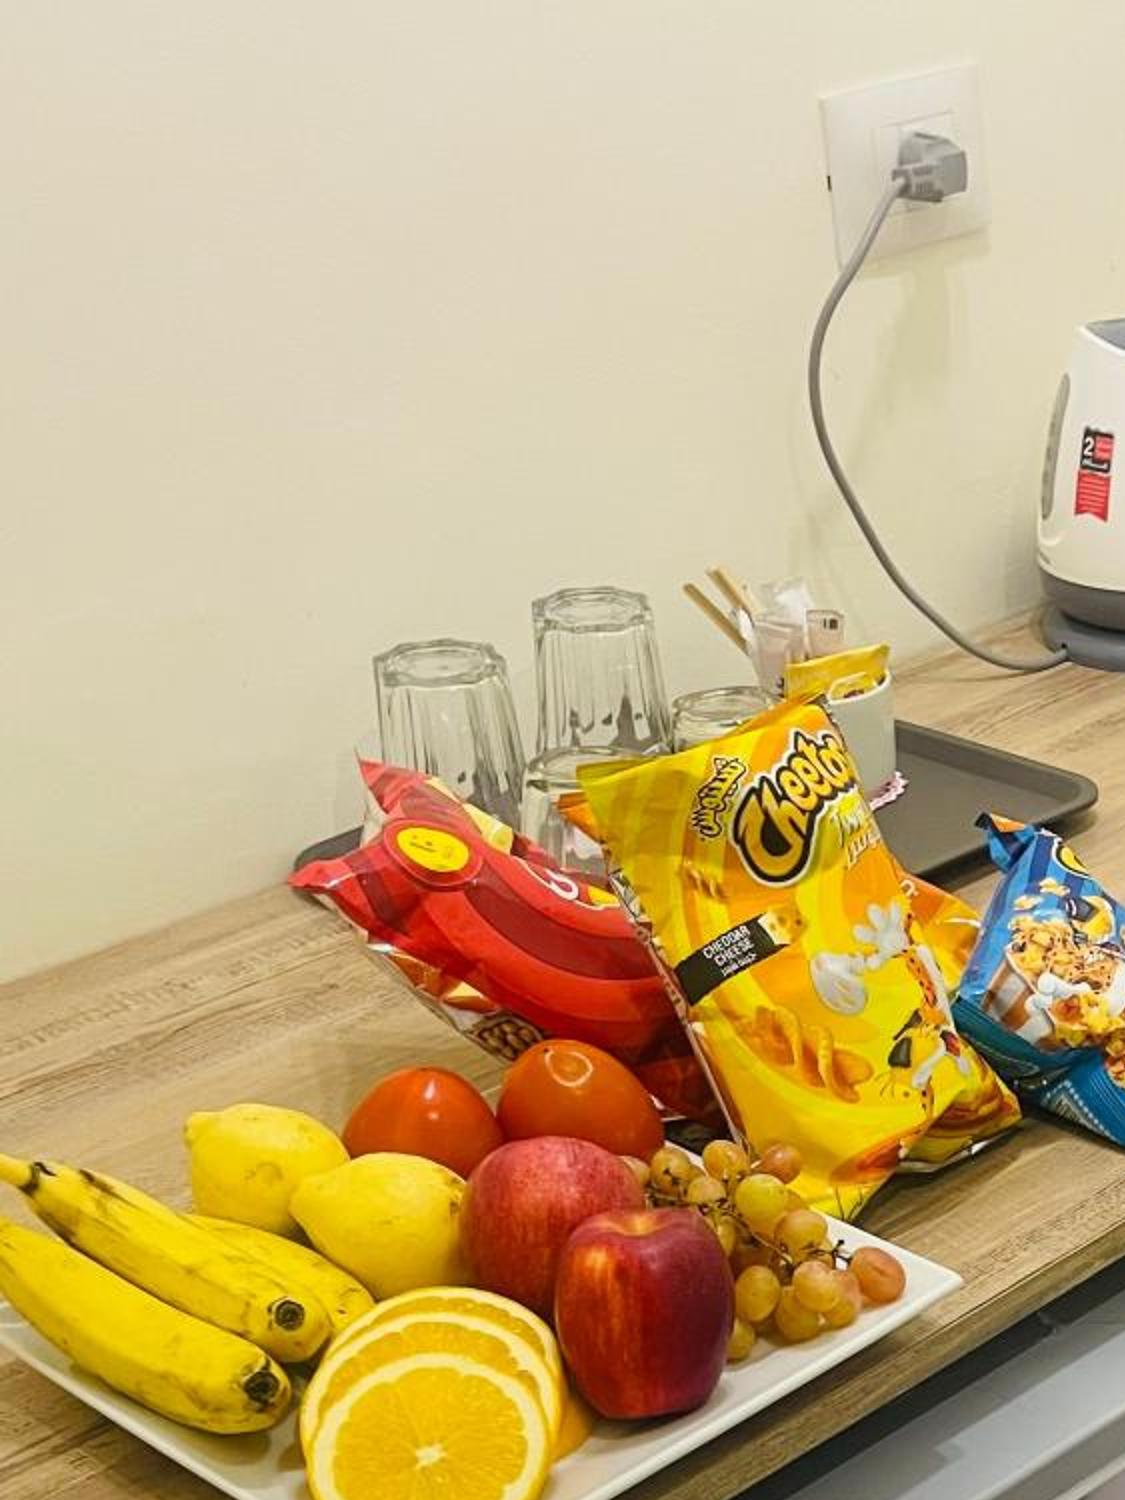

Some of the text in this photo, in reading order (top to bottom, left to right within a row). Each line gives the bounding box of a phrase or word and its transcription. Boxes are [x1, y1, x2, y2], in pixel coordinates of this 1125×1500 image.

[1083, 436, 1095, 457] 2
[702, 925, 751, 960] CHEDDAR
[713, 938, 756, 967] CHEESE
